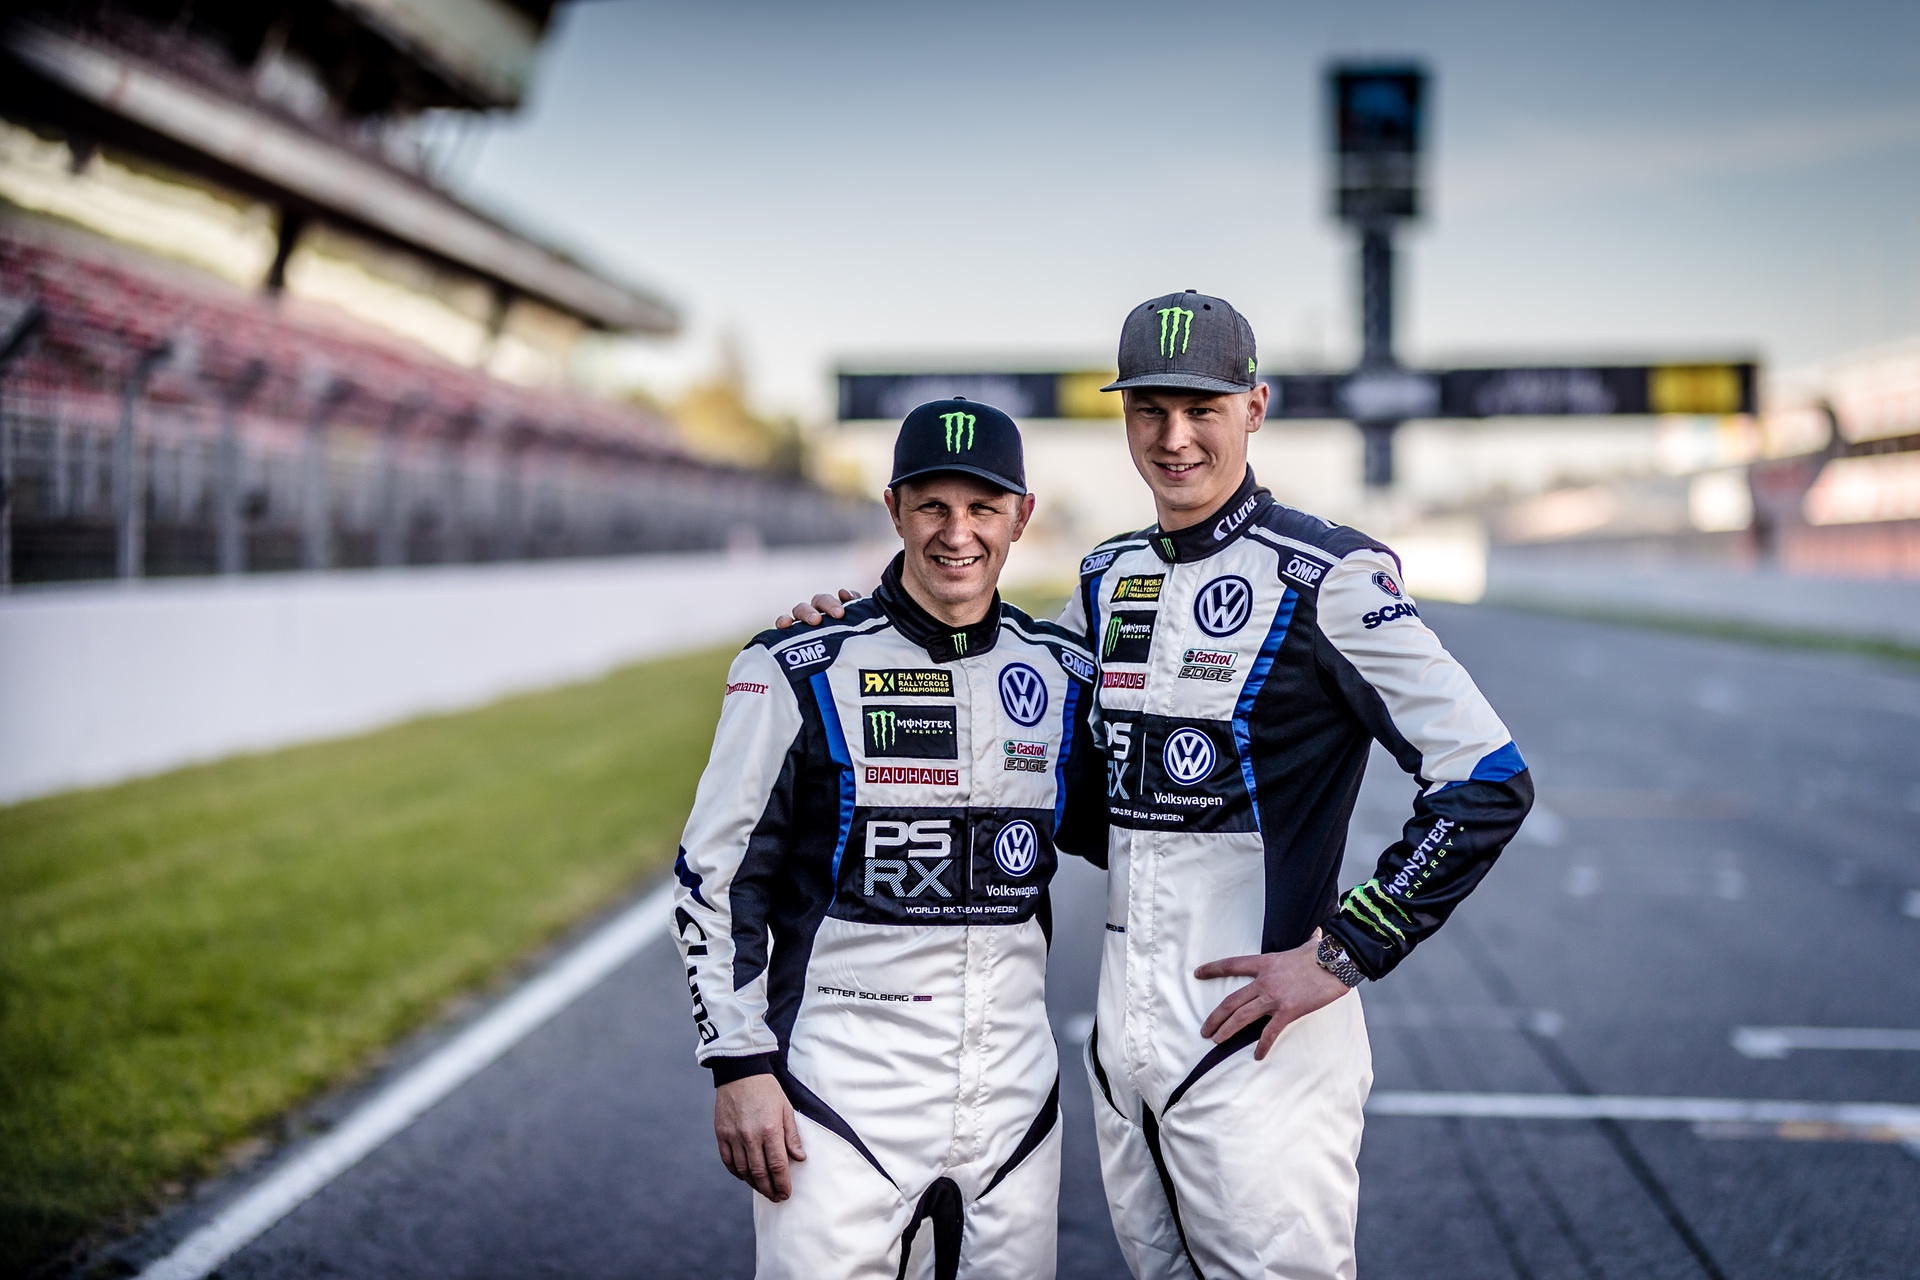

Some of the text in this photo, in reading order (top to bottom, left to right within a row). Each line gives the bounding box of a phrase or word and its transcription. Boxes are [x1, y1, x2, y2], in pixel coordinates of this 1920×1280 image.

[1082, 553, 1114, 572] OMP
[1287, 559, 1321, 582] OMP
[786, 644, 826, 665] OMP
[1194, 651, 1232, 665] Castrol
[1062, 652, 1095, 677] OMP
[898, 673, 949, 681] FIA WORLD
[1178, 665, 1236, 682] EDGE
[896, 718, 952, 729] MONSTER
[1017, 743, 1045, 756] Castrol
[1004, 758, 1048, 773] EDGE
[867, 768, 957, 783] BAUHAUS
[1153, 792, 1223, 808] Volkswagen
[1150, 813, 1184, 821] SWEDEN
[865, 820, 951, 858] PS
[1405, 838, 1454, 898] ENERGY
[863, 859, 953, 897] RX
[986, 885, 1038, 898] Volkswagen
[906, 906, 940, 914] WORLD
[943, 906, 956, 914] RX
[984, 906, 1018, 914] SWEDEN
[818, 986, 909, 1002] PETTER SOLBERG
